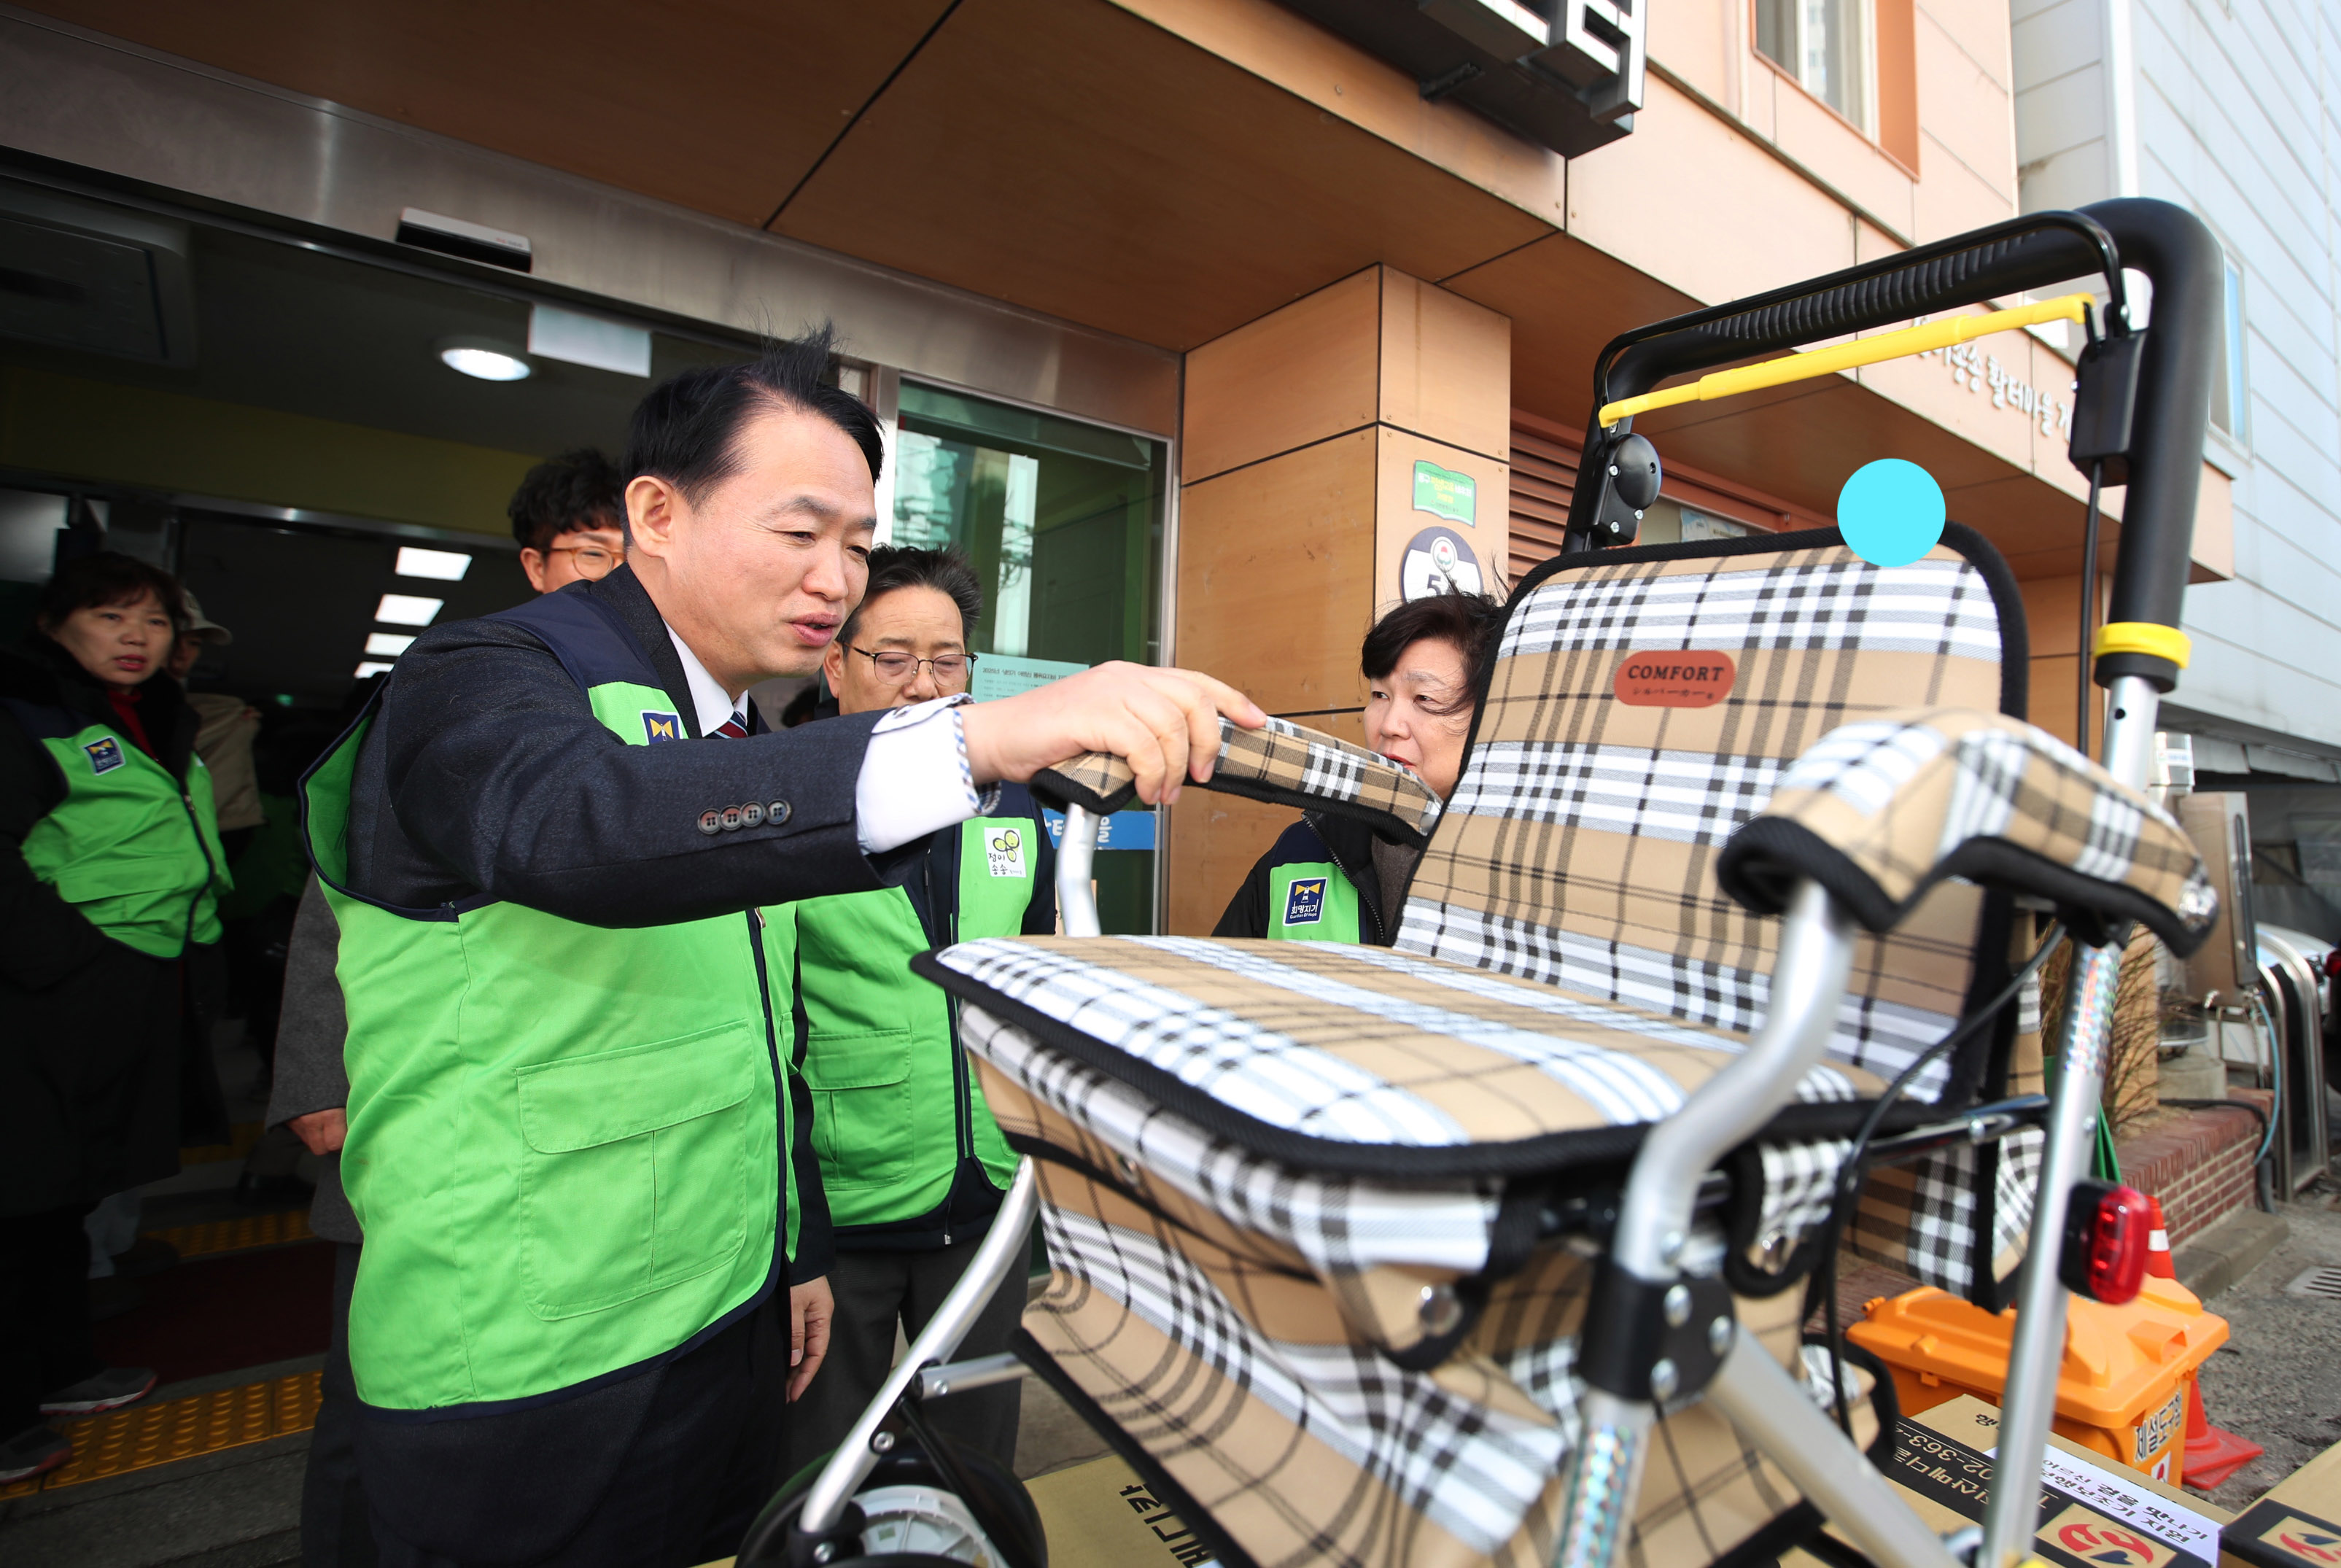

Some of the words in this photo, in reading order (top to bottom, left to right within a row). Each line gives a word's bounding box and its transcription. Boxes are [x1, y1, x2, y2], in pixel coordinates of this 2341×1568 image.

[1628, 665, 1724, 681] COMFORT
[992, 863, 1008, 875] 송송
[1291, 899, 1319, 915] 희망지기
[2135, 1390, 2181, 1462] 제설도구함
[1896, 1424, 1994, 1480] 02-363-
[2042, 1459, 2092, 1484] 어르신
[2041, 1465, 2136, 1517] 보행보조기
[2140, 1517, 2190, 1544] 지원
